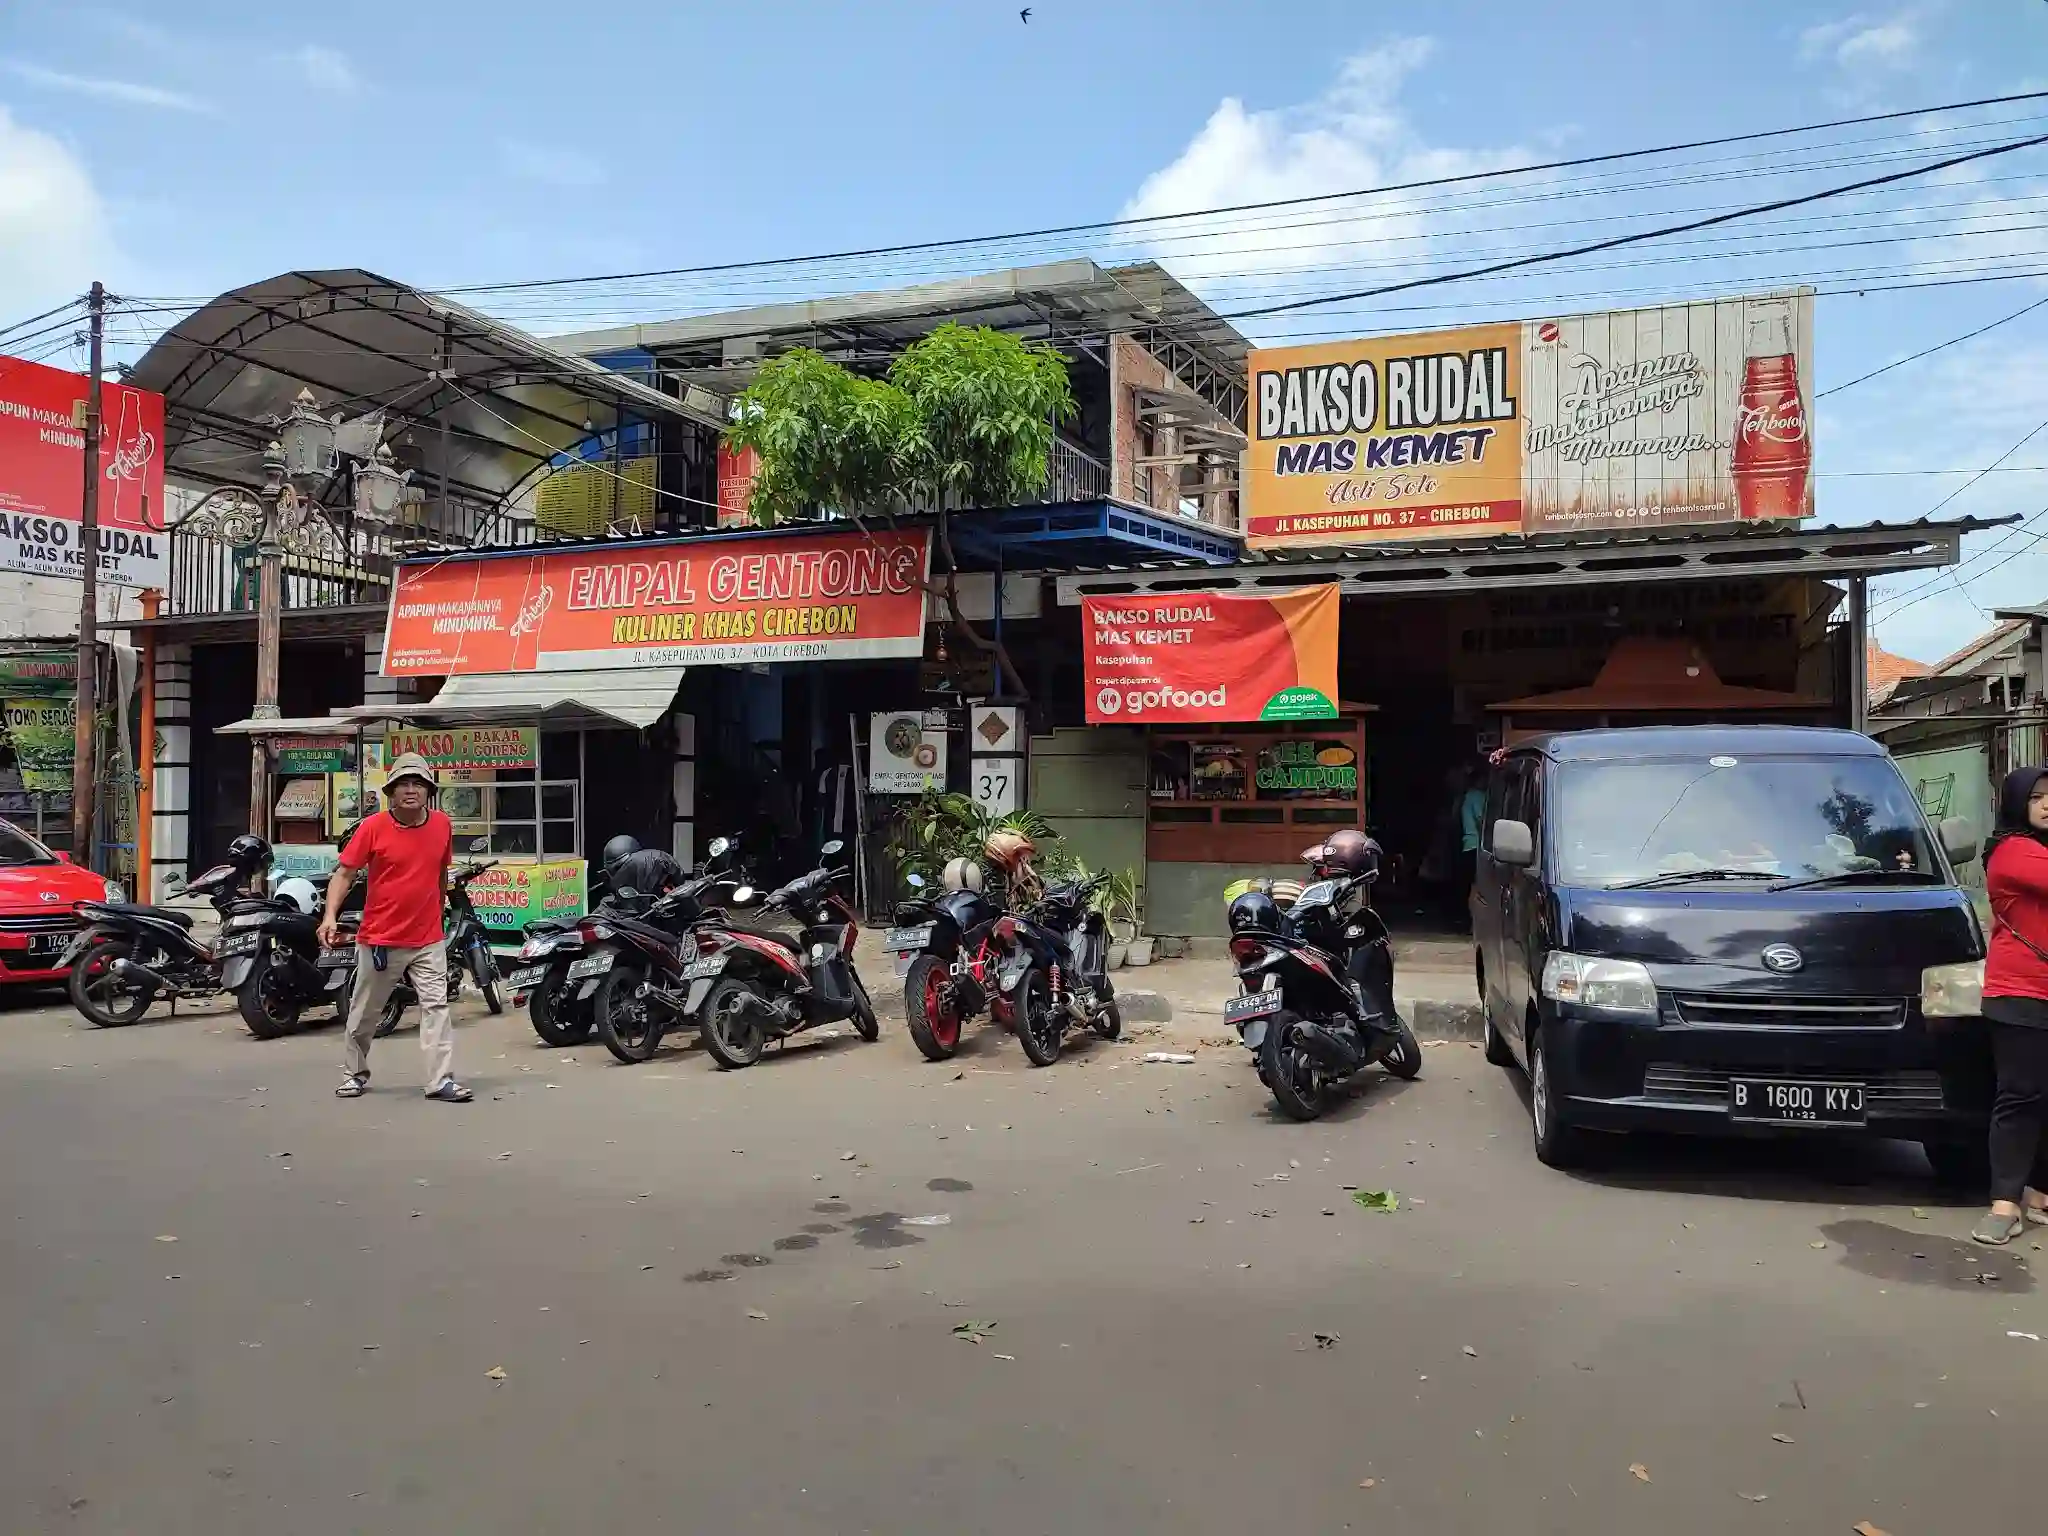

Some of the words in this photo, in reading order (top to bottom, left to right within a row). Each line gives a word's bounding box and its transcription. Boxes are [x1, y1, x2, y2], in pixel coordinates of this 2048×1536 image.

[1258, 361, 1377, 439] BAKSO
[1387, 349, 1515, 428] RUDAL
[1560, 352, 1698, 413] Apapun
[1277, 438, 1357, 475] MAS
[1366, 427, 1494, 469] KEMET
[1325, 478, 1376, 503] Asli
[1380, 473, 1438, 500] Solo
[1276, 520, 1289, 532] JL
[1293, 515, 1368, 531] KASEPUHAN
[1373, 513, 1395, 526] NO.
[1399, 511, 1416, 523] 37
[1430, 506, 1490, 522] CIREBON
[20, 543, 58, 562] MAS
[64, 549, 121, 570] KEET
[567, 559, 695, 611] EMPAL
[708, 545, 916, 602] GENTONG
[612, 611, 695, 643] KULINER
[701, 609, 757, 639] KHAS
[762, 604, 857, 636] CIREBON
[1094, 609, 1150, 624] BAKSO
[1155, 606, 1216, 623] RUDAL
[1095, 630, 1131, 645] MAS
[1135, 628, 1194, 645] KEMET
[649, 648, 706, 662] KASEPUHAN
[752, 646, 779, 658] KOTA
[783, 643, 828, 657] CIREBON
[1096, 654, 1153, 667] Kasepuhan
[1126, 684, 1226, 713] gofood
[6, 708, 37, 726] TOKO
[391, 733, 454, 757] BAKSO
[473, 729, 520, 743] BAKAR
[473, 741, 529, 757] GORENG
[448, 759, 488, 768] ANEKA
[491, 758, 524, 768] SAUS
[979, 775, 1008, 800] 37
[1256, 766, 1357, 789] CAMPUR
[1735, 1083, 1748, 1106] B
[1766, 1085, 1813, 1108] 1600
[1826, 1086, 1864, 1111] KYJ
[1782, 1110, 1817, 1120] 11-22
